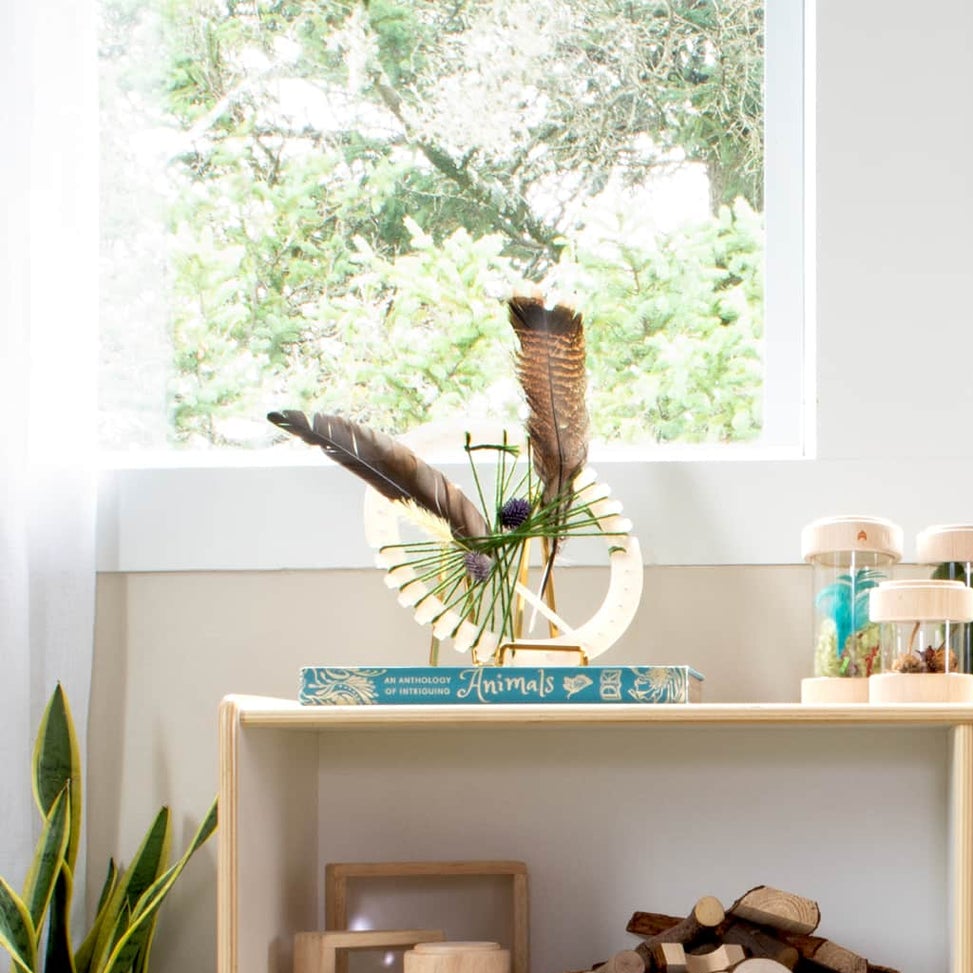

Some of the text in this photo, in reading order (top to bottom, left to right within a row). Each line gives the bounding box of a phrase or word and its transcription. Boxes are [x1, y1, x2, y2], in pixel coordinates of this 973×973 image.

[384, 676, 452, 684] AN ANTHOLOGY
[456, 667, 555, 703] Animals
[385, 687, 451, 695] OF INTRIGUING
